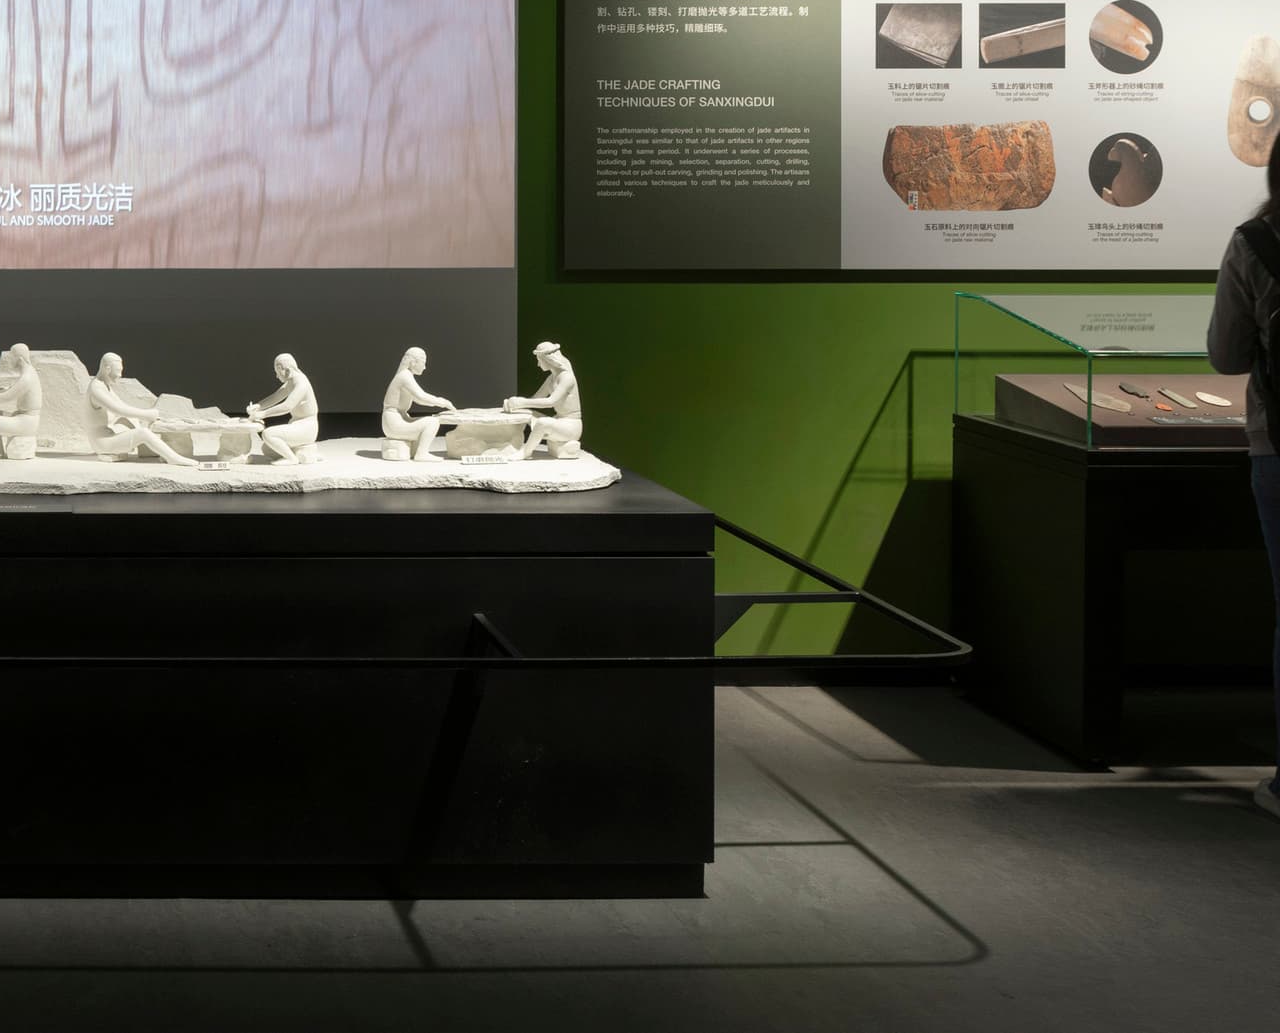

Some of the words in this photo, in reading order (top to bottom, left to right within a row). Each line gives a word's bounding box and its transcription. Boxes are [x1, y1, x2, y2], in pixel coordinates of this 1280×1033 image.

[597, 80, 622, 90] THE
[624, 80, 656, 90] JADE
[659, 80, 721, 90] CRAFTING
[597, 97, 676, 108] TECHNIQUES
[679, 97, 696, 108] OF
[699, 97, 774, 108] SANXINGDUI
[597, 127, 609, 135] The
[612, 127, 658, 135] craftsmanship
[661, 127, 693, 135] employed
[696, 127, 702, 135] in
[705, 127, 715, 135] the
[719, 127, 745, 135] creation
[748, 127, 754, 135] of
[757, 127, 771, 135] jade
[774, 127, 801, 135] artifacts
[804, 127, 810, 135] in
[597, 137, 633, 146] Sanxingdui
[636, 137, 649, 146] was
[652, 137, 673, 146] similar
[676, 137, 683, 146] to
[686, 137, 698, 146] that
[701, 137, 708, 146] of
[711, 137, 725, 146] jade
[728, 137, 754, 146] artifacts
[757, 137, 763, 146] in
[766, 137, 782, 146] other
[785, 137, 810, 146] regions
[597, 148, 618, 156] during
[622, 148, 632, 156] the
[636, 148, 654, 156] same
[658, 148, 681, 156] period.
[684, 148, 689, 156] It
[693, 148, 728, 156] underwent
[731, 148, 736, 156] a
[740, 148, 760, 156] series
[763, 148, 770, 156] of
[774, 148, 810, 156] processes,
[597, 158, 626, 167] including
[630, 158, 646, 167] jade
[650, 158, 675, 167] mining,
[678, 158, 711, 167] selection,
[715, 158, 752, 167] separation,
[756, 158, 781, 167] cutting,
[785, 158, 810, 167] drilling,
[597, 168, 631, 177] hollow-out
[633, 168, 639, 177] or
[641, 168, 666, 177] pull-out
[667, 168, 694, 177] carving,
[695, 168, 722, 177] grinding
[724, 168, 736, 177] and
[738, 168, 768, 177] polishing.
[770, 168, 782, 177] The
[784, 168, 810, 177] artisans
[597, 179, 620, 187] utilized
[624, 179, 647, 187] various
[651, 179, 687, 187] techniques
[691, 179, 698, 187] to
[702, 179, 717, 187] craft
[721, 179, 731, 187] the
[734, 179, 749, 187] jade
[753, 179, 793, 187] meticulously
[797, 179, 810, 187] and
[29, 183, 134, 212] 丽质光洁
[597, 190, 636, 198] elaborately.
[10, 215, 34, 226] AND
[35, 215, 85, 226] SMOOTH
[86, 215, 114, 226] JADE
